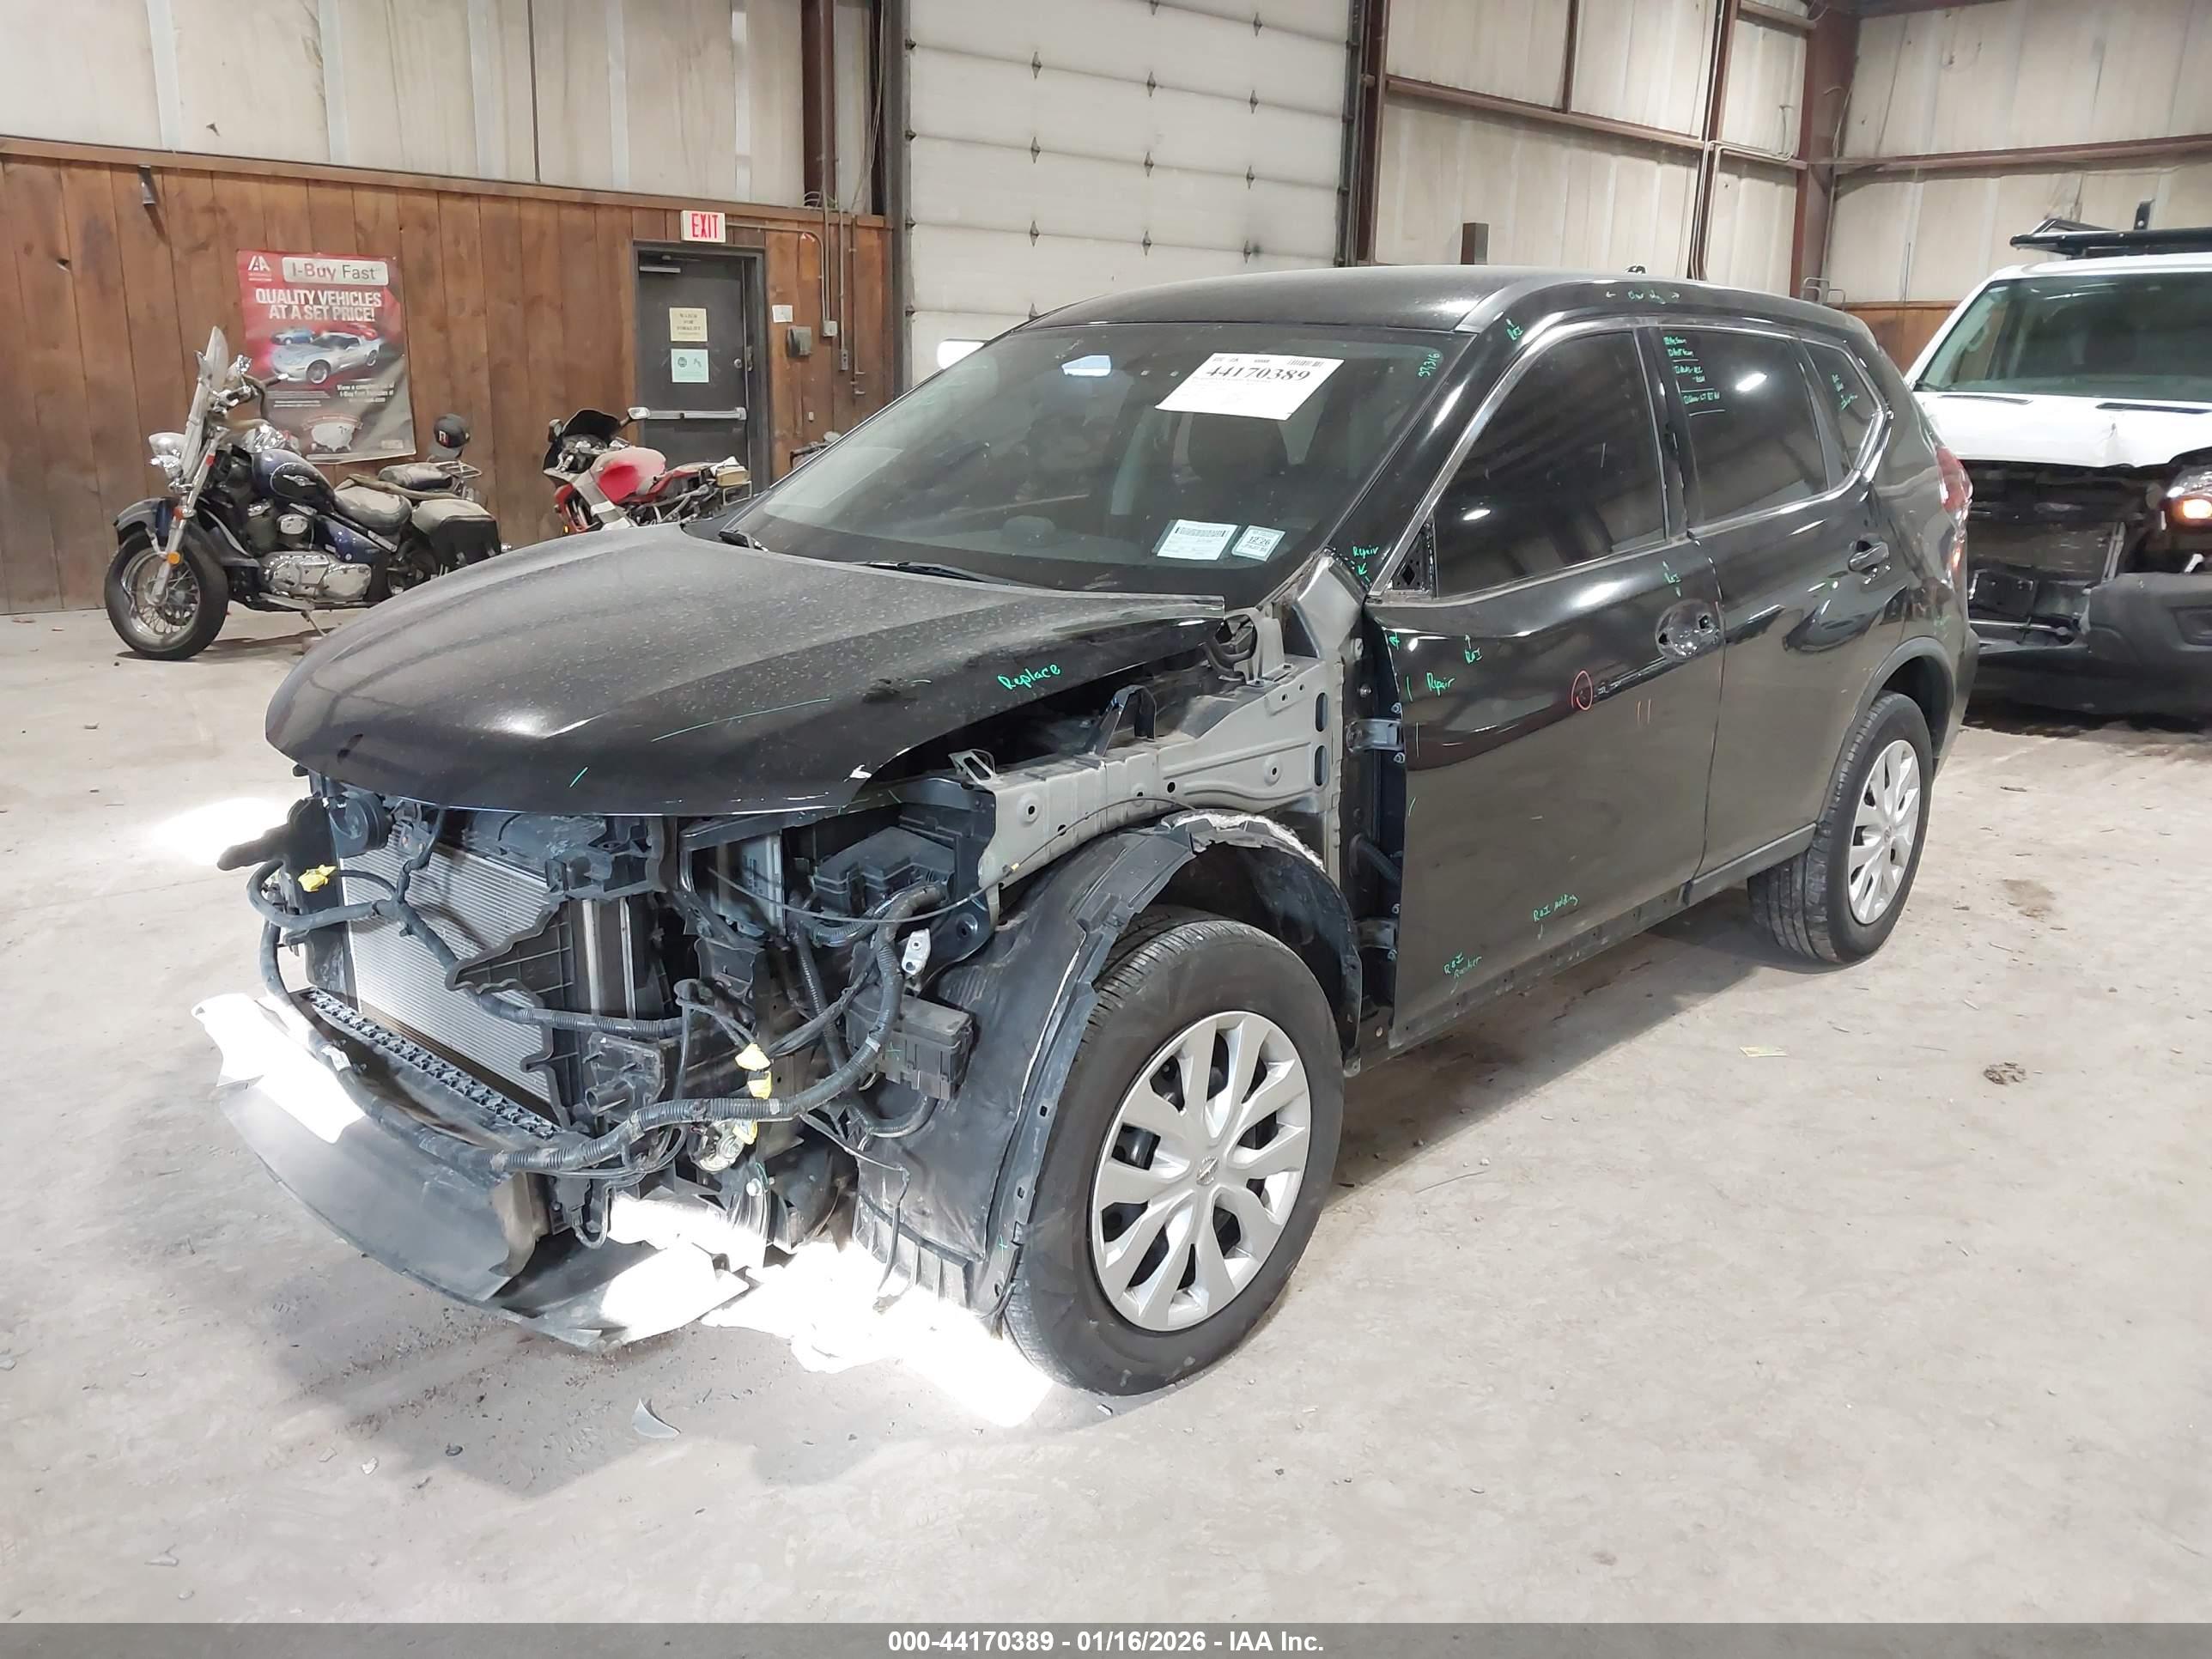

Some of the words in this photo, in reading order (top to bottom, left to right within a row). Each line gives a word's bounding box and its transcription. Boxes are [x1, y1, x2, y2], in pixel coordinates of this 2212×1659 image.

[690, 213, 719, 240] EXIT
[292, 262, 337, 281] I-Buy
[342, 264, 377, 280] Fast
[255, 288, 315, 306] QUALITY
[317, 291, 383, 307] VEHICLES
[269, 304, 288, 320] AT
[290, 305, 302, 320] A
[303, 306, 331, 321] SET
[331, 307, 376, 322] PRICE!
[1206, 366, 1311, 381] 44170389
[1352, 545, 1379, 558] Repair
[997, 664, 1060, 690] Replace
[1426, 672, 1455, 696] Repair
